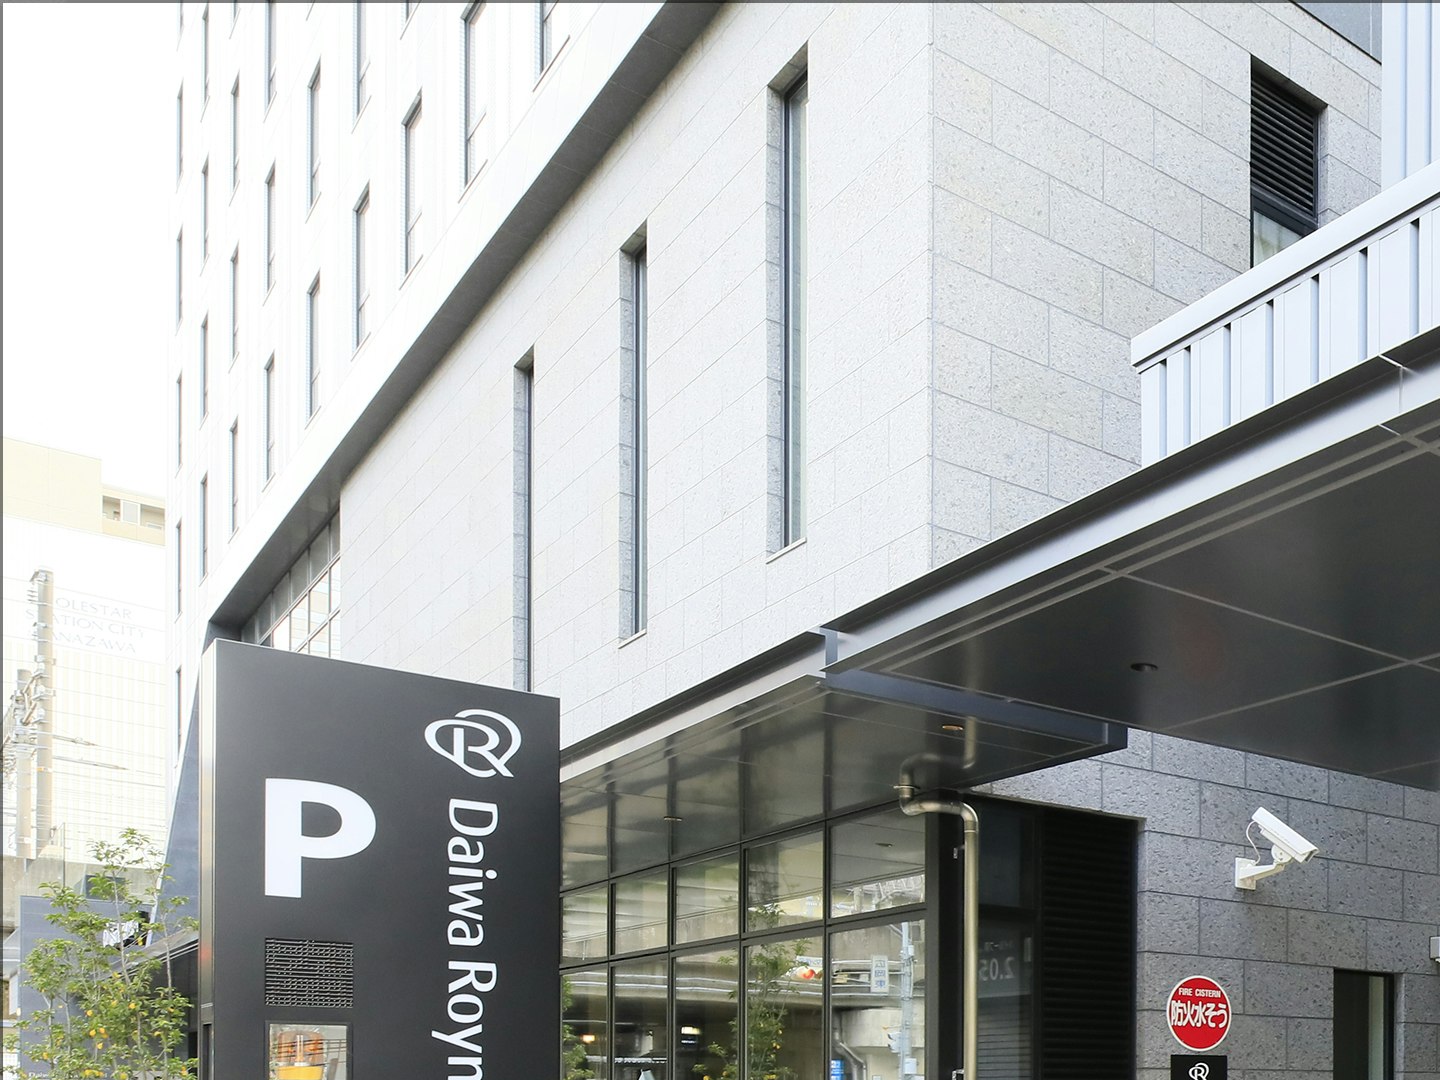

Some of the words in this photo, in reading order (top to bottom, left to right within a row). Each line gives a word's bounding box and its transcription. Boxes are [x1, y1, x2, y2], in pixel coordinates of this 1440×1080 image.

[55, 597, 132, 619] OLESTAR
[265, 778, 376, 898] P
[447, 798, 498, 946] Daiwa
[1178, 987, 1193, 996] FIRE
[1195, 988, 1221, 998] CISTERN
[1171, 1000, 1228, 1028] 防火水そう
